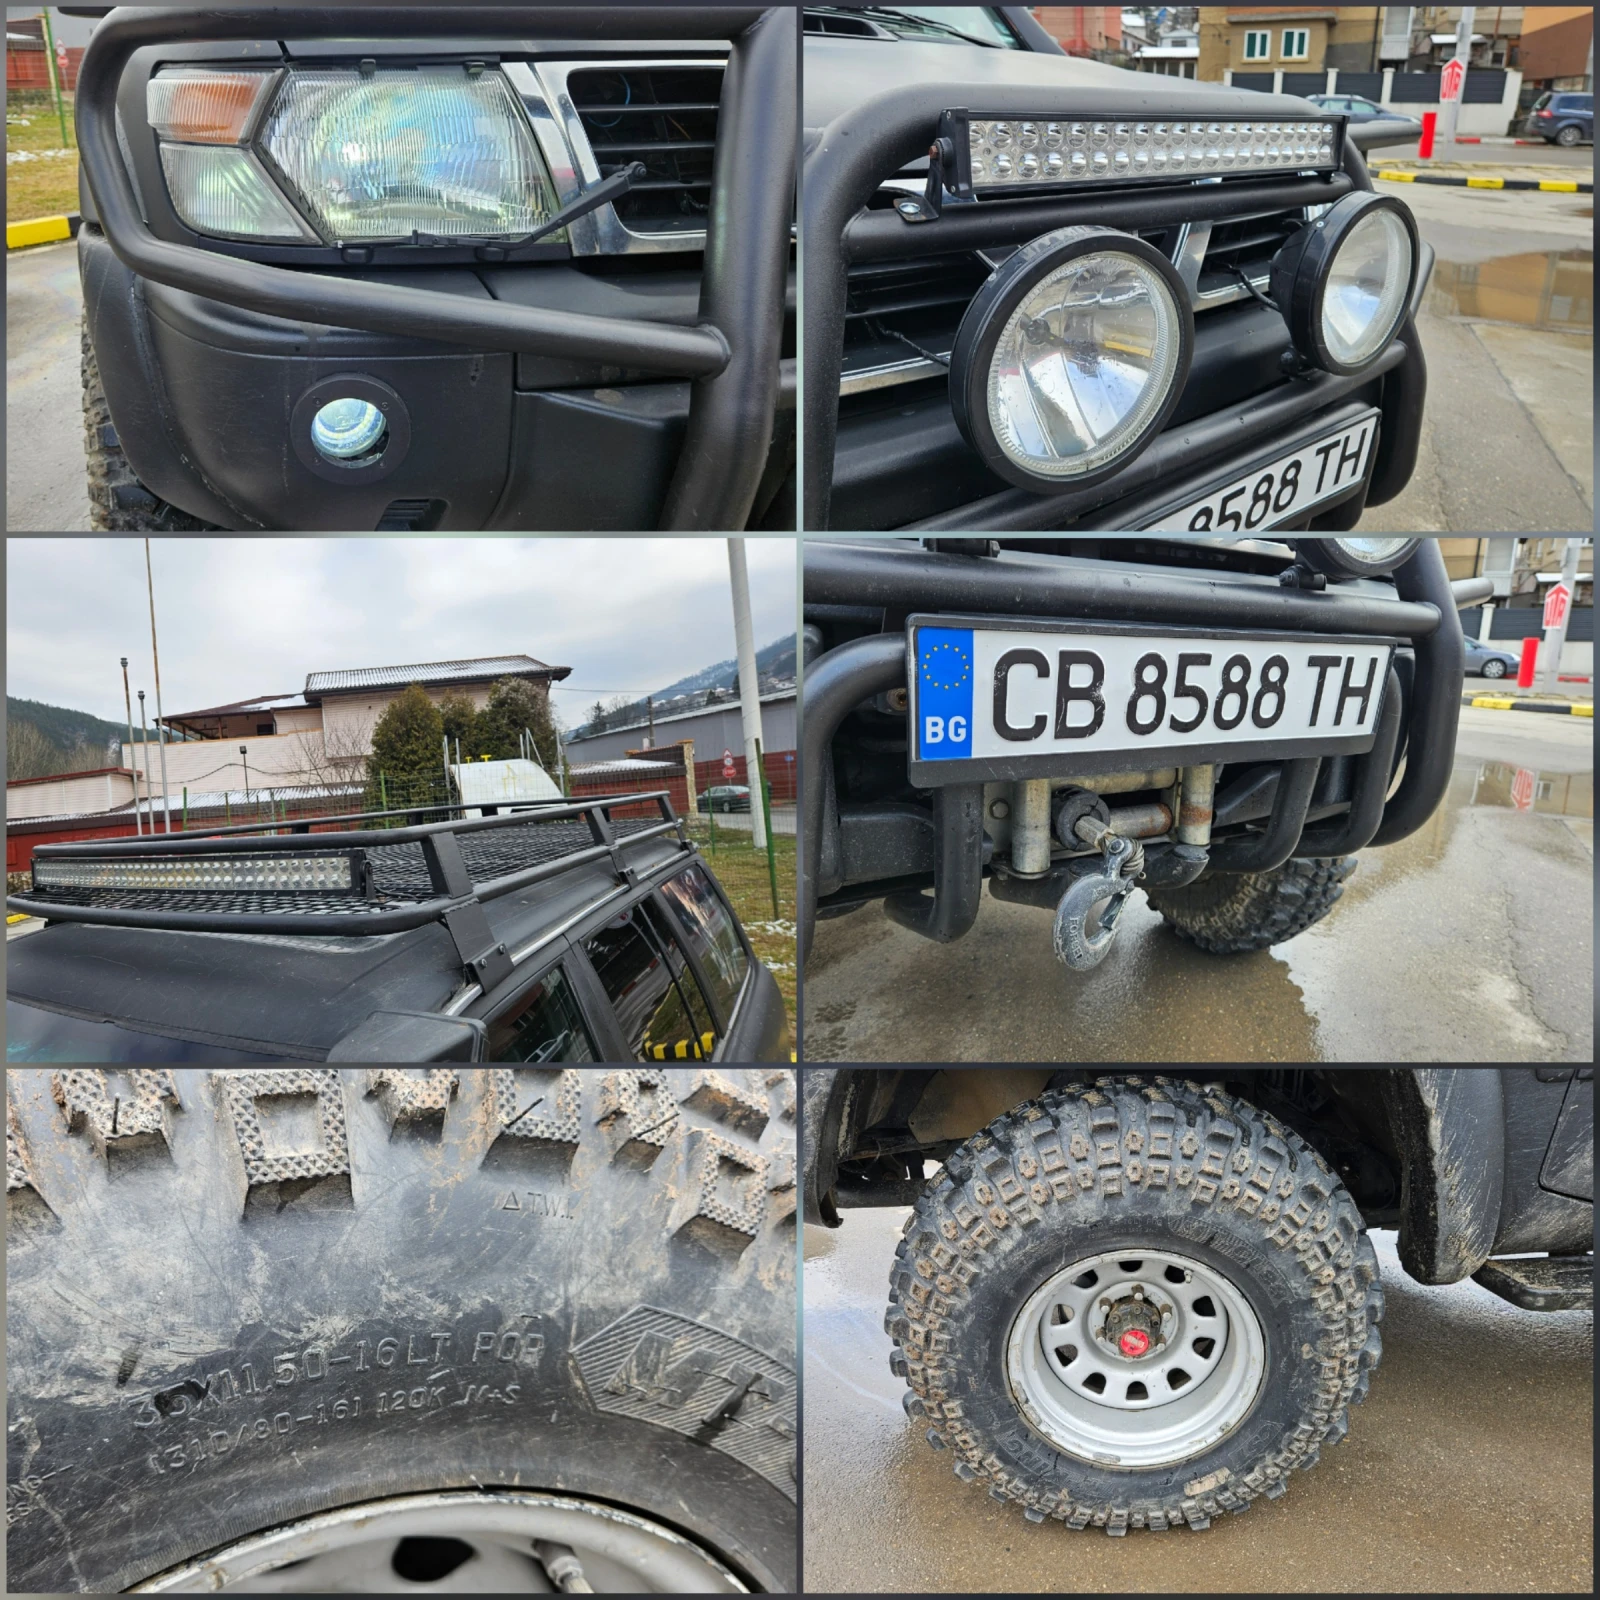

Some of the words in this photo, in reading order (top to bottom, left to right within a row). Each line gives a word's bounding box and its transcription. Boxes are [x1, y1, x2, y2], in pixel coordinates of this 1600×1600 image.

[1315, 427, 1368, 495] TH
[992, 647, 1105, 742] CB
[1125, 651, 1290, 736] 8588
[1307, 654, 1379, 728] TH
[925, 716, 967, 744] BG
[377, 1385, 446, 1414] 120K
